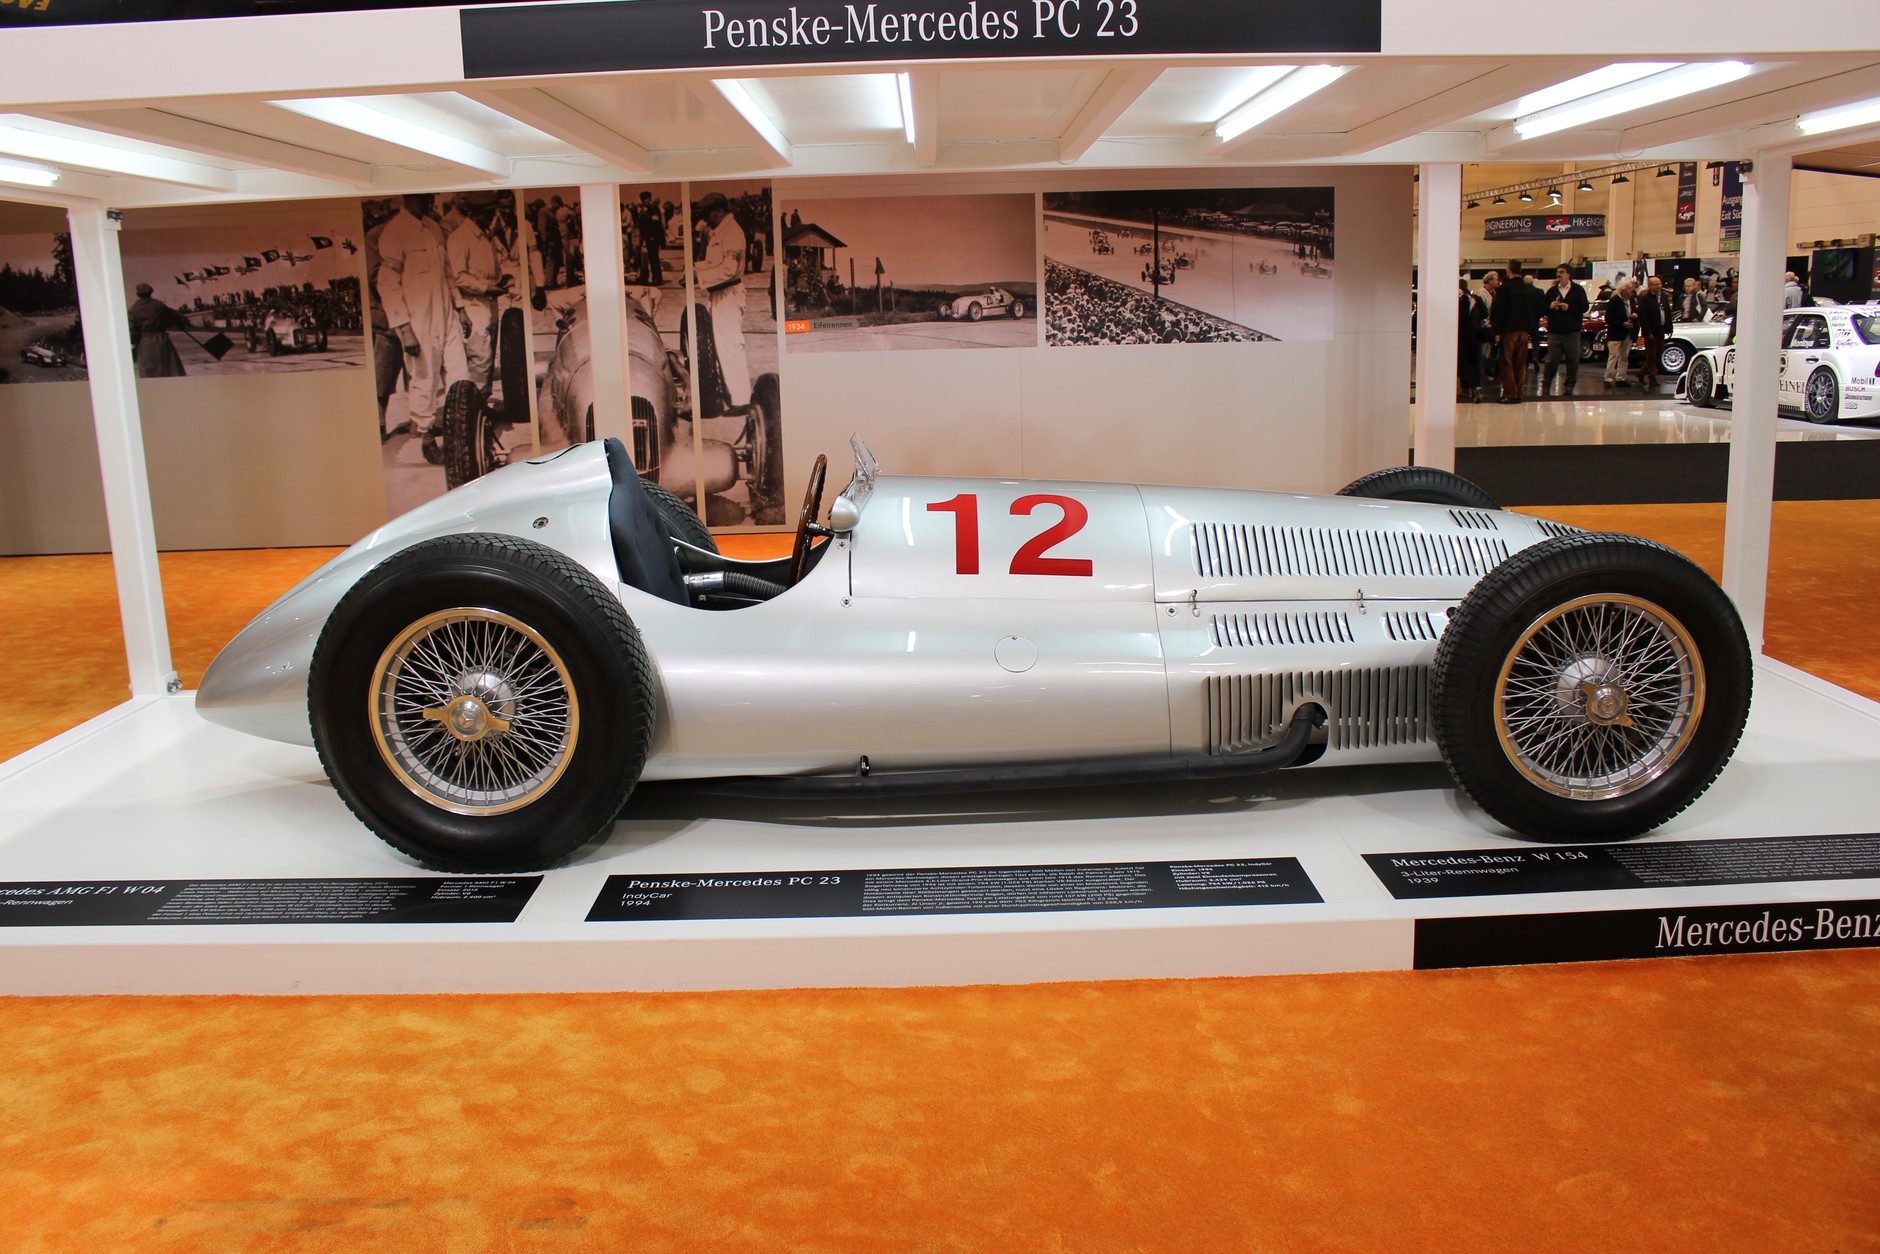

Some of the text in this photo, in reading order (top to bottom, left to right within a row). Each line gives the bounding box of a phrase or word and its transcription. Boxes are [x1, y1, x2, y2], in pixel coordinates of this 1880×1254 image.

[702, 0, 1139, 50] Penske-Mercedes PC 23
[1722, 210, 1731, 220] Exit
[813, 320, 853, 329] Eifelrennen
[926, 494, 1093, 576] 12
[1390, 851, 1589, 867] Mercedes-Benz W 154
[1401, 867, 1519, 877] 3-Liter-Rennwagen
[628, 878, 782, 888] Penske-Mercedes
[788, 877, 813, 885] PC
[0, 887, 45, 895] cedes
[47, 886, 94, 894] AMG
[94, 886, 118, 894] F1
